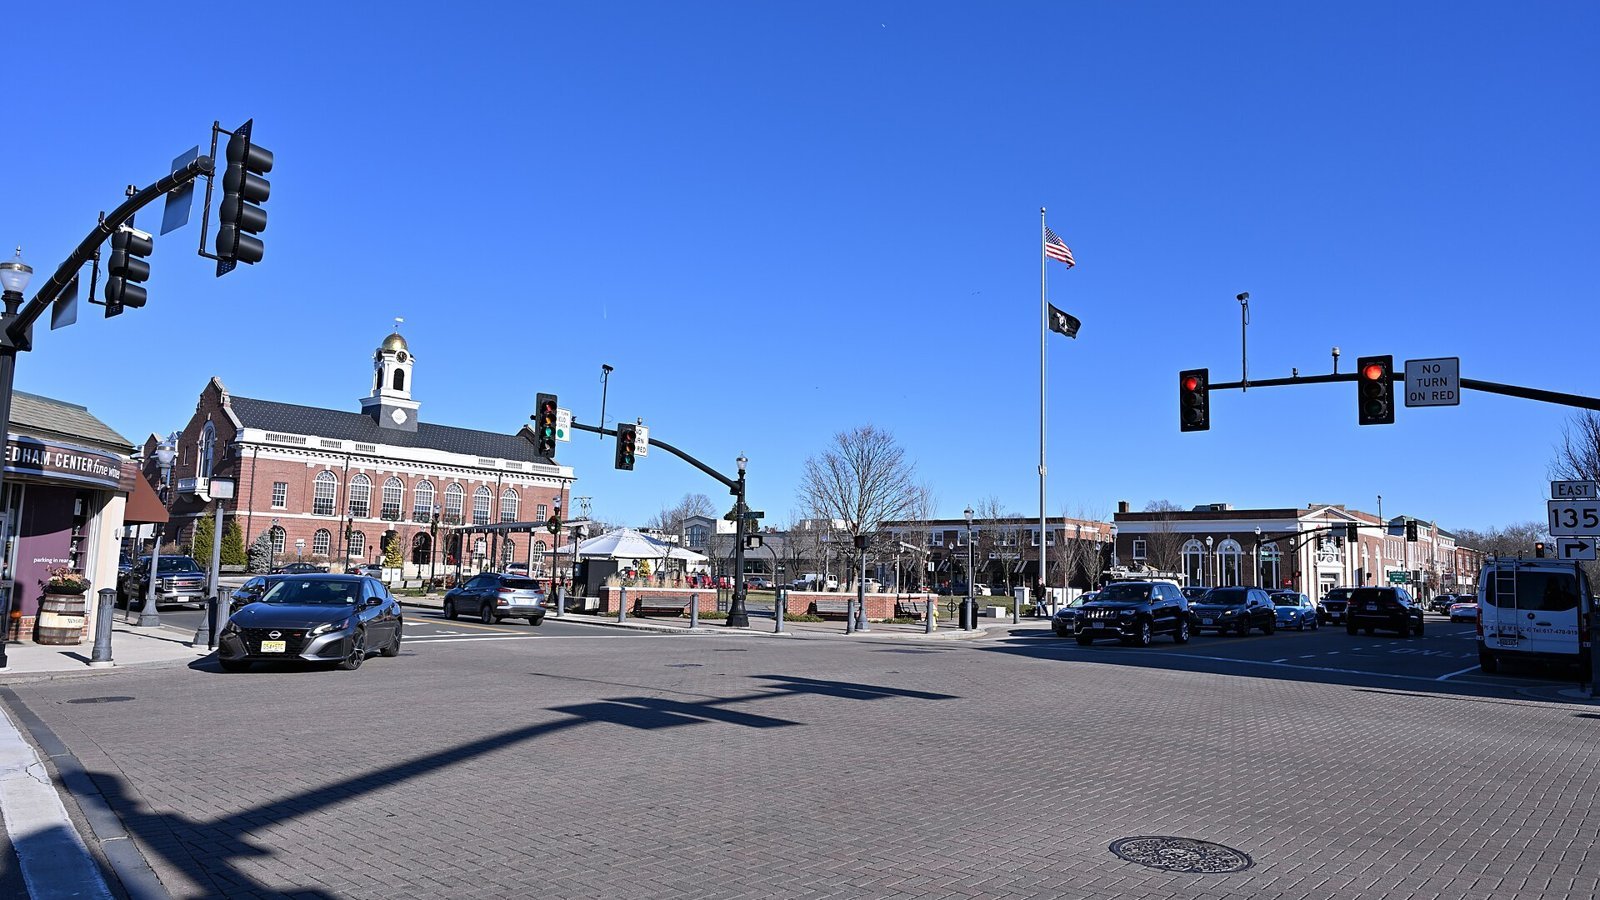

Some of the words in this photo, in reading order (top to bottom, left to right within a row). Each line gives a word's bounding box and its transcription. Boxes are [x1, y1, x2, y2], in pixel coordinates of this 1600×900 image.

[1422, 364, 1441, 374] NO
[1416, 377, 1447, 387] TURN
[1410, 391, 1425, 401] ON
[1432, 390, 1454, 400] RED
[55, 453, 92, 473] CENTER
[93, 459, 108, 476] fine
[1558, 484, 1589, 496] EAST
[1552, 508, 1599, 528] 135
